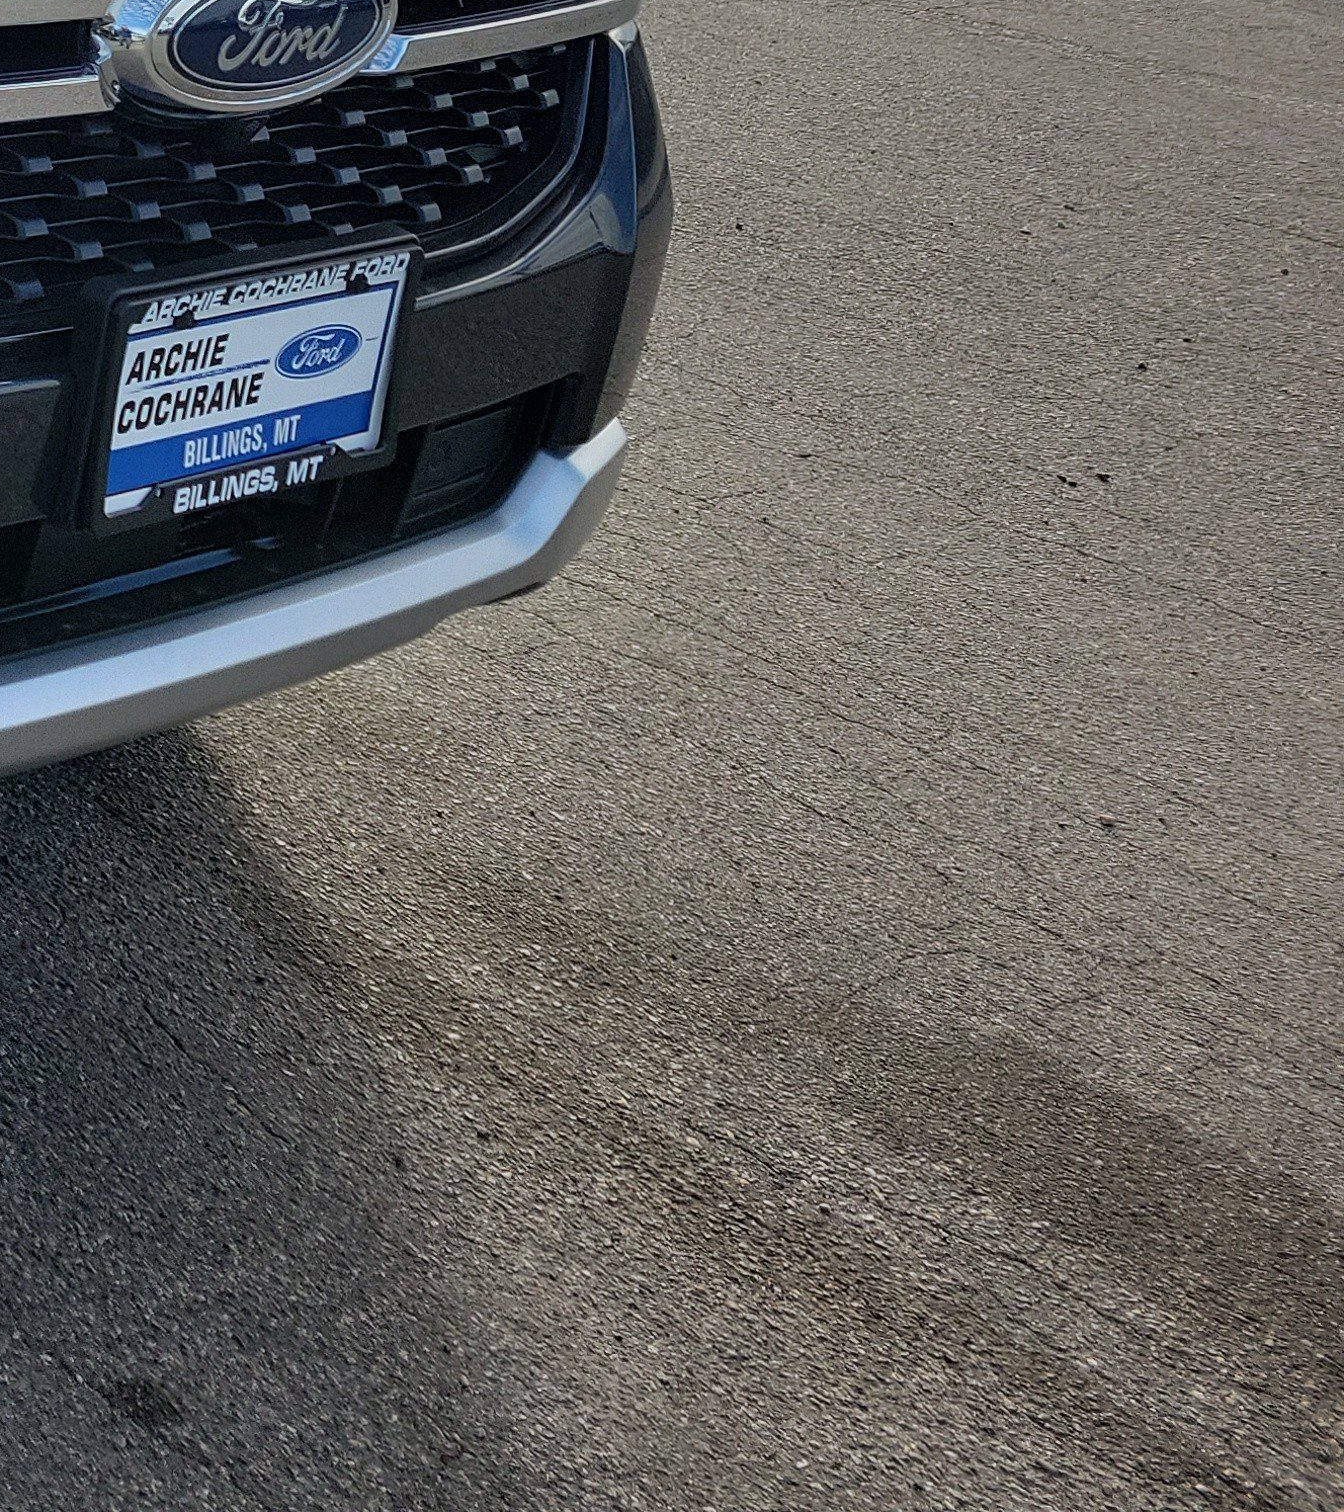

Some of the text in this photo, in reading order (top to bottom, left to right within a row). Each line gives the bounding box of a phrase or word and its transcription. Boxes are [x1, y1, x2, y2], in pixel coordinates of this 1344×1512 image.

[140, 251, 411, 325] ARCHIE COCHRANE FORD
[125, 333, 231, 385] ARCHIE
[292, 333, 346, 370] Ford
[117, 372, 265, 435] COCHRANE
[183, 414, 302, 469] BILLINGS, MT
[172, 454, 324, 515] BILLINGS, MT
